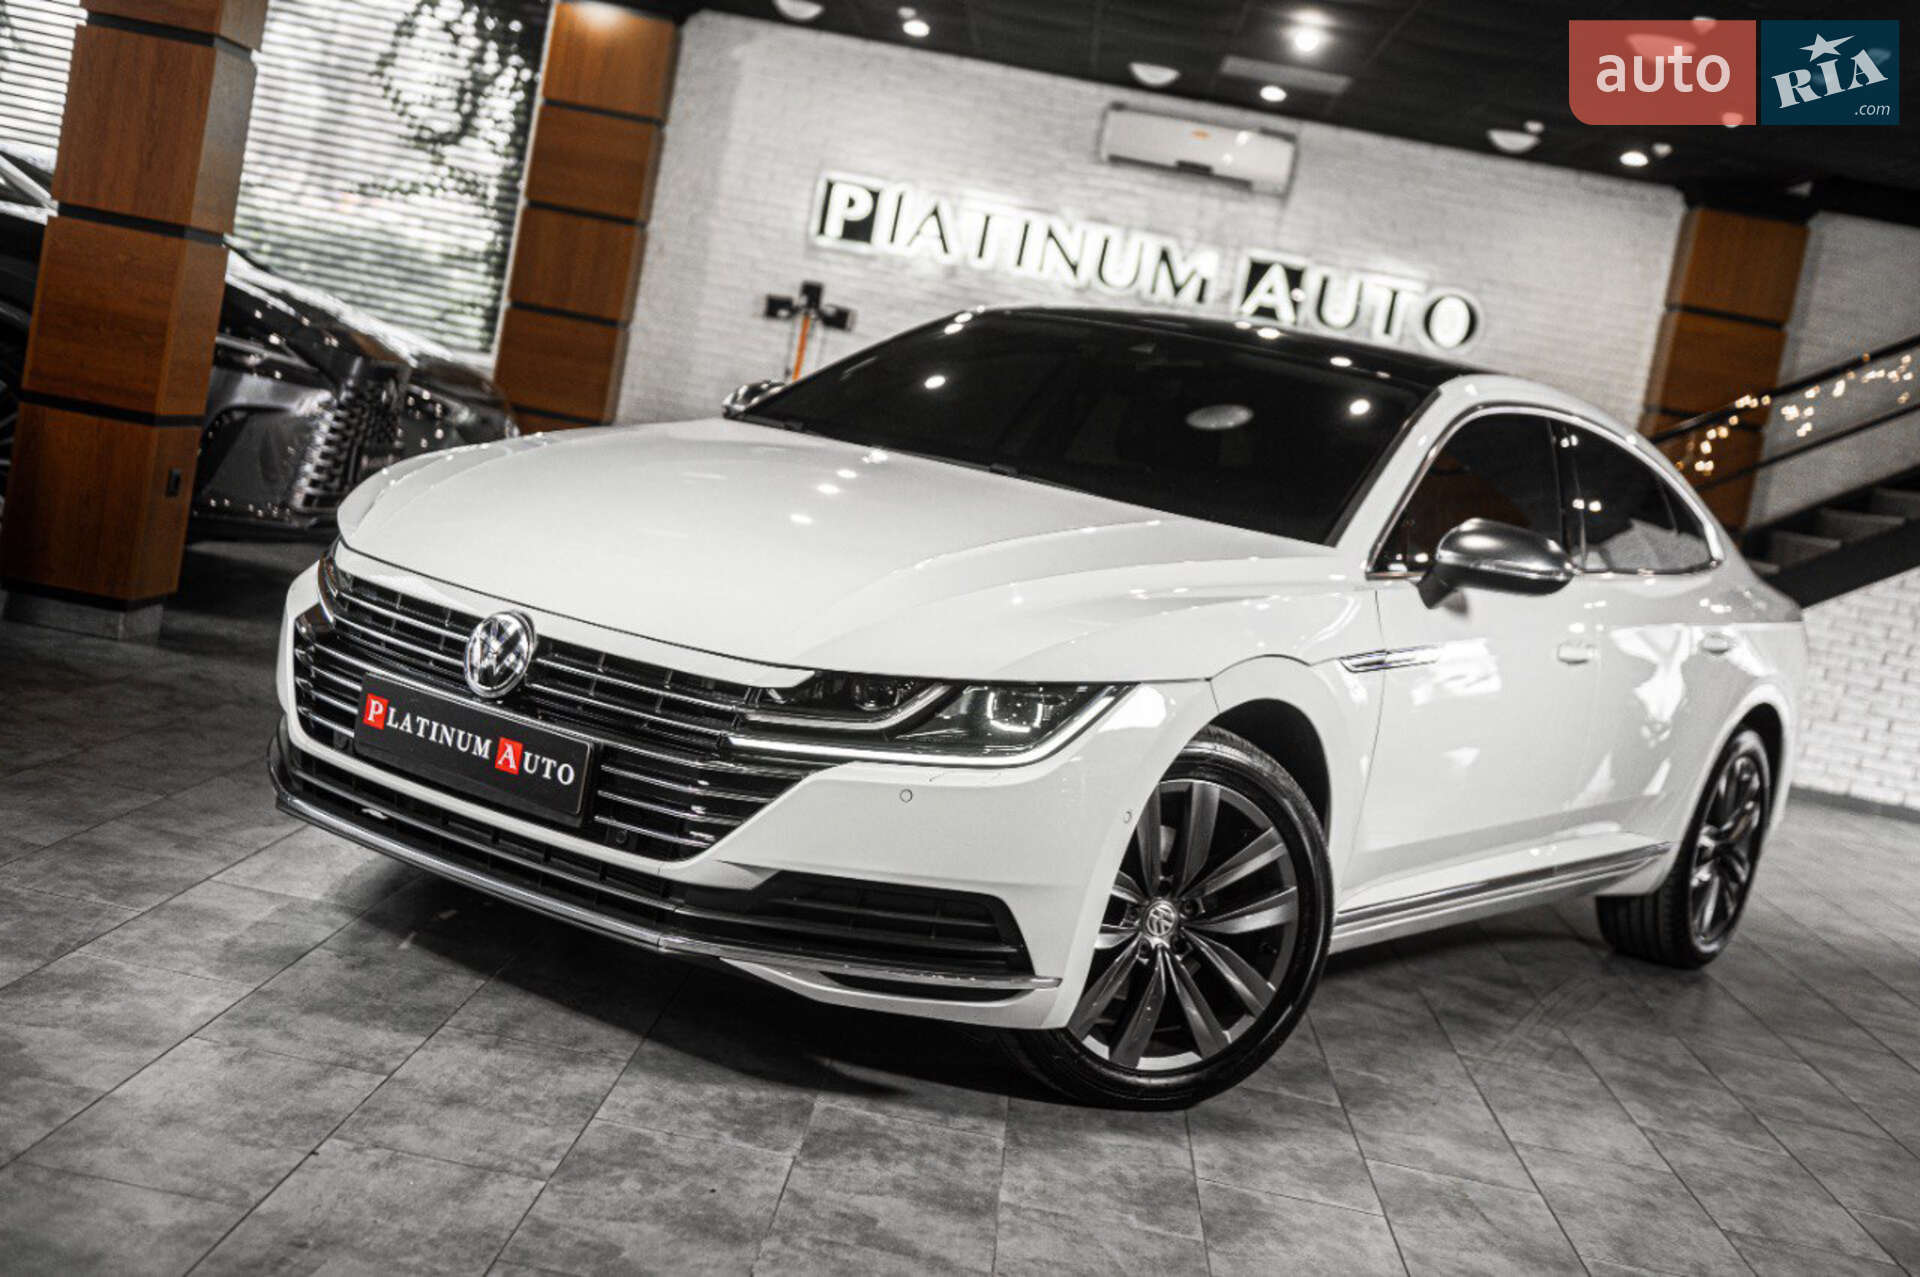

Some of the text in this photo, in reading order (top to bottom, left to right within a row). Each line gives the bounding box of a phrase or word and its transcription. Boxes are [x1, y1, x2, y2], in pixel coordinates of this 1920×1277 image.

[1240, 256, 1480, 349] AUTO
[364, 694, 575, 786] PLATINUM AUTO
